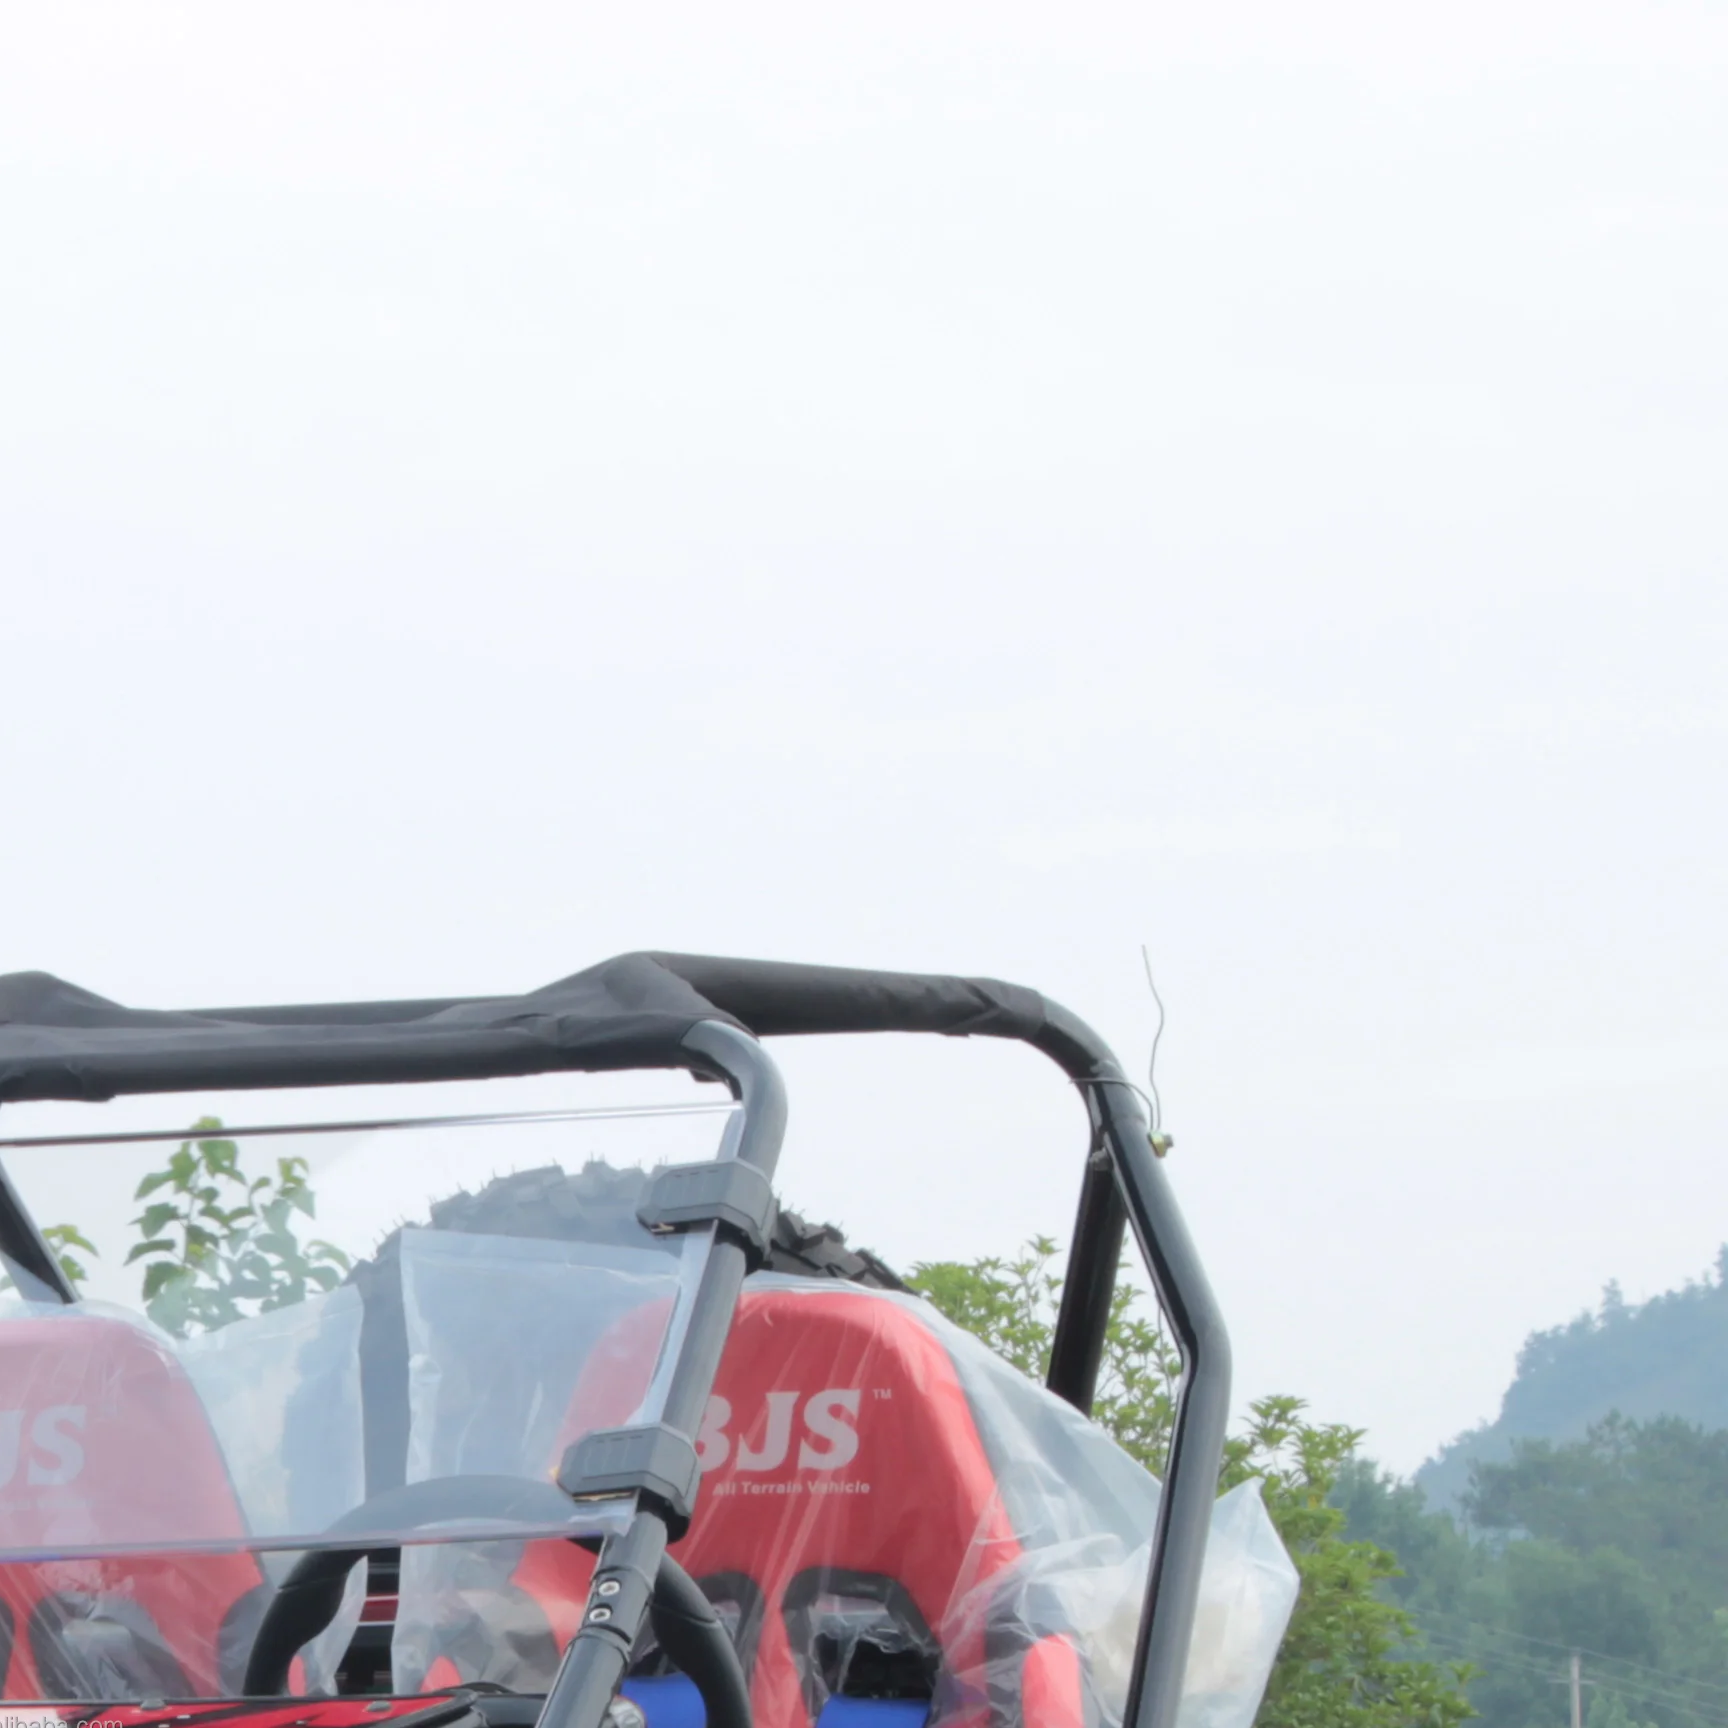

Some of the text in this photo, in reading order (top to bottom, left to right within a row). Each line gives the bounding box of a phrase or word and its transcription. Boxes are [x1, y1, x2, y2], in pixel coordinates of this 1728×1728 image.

[694, 1388, 862, 1473] BJS
[712, 1479, 871, 1496] All Terrain Vehicle
